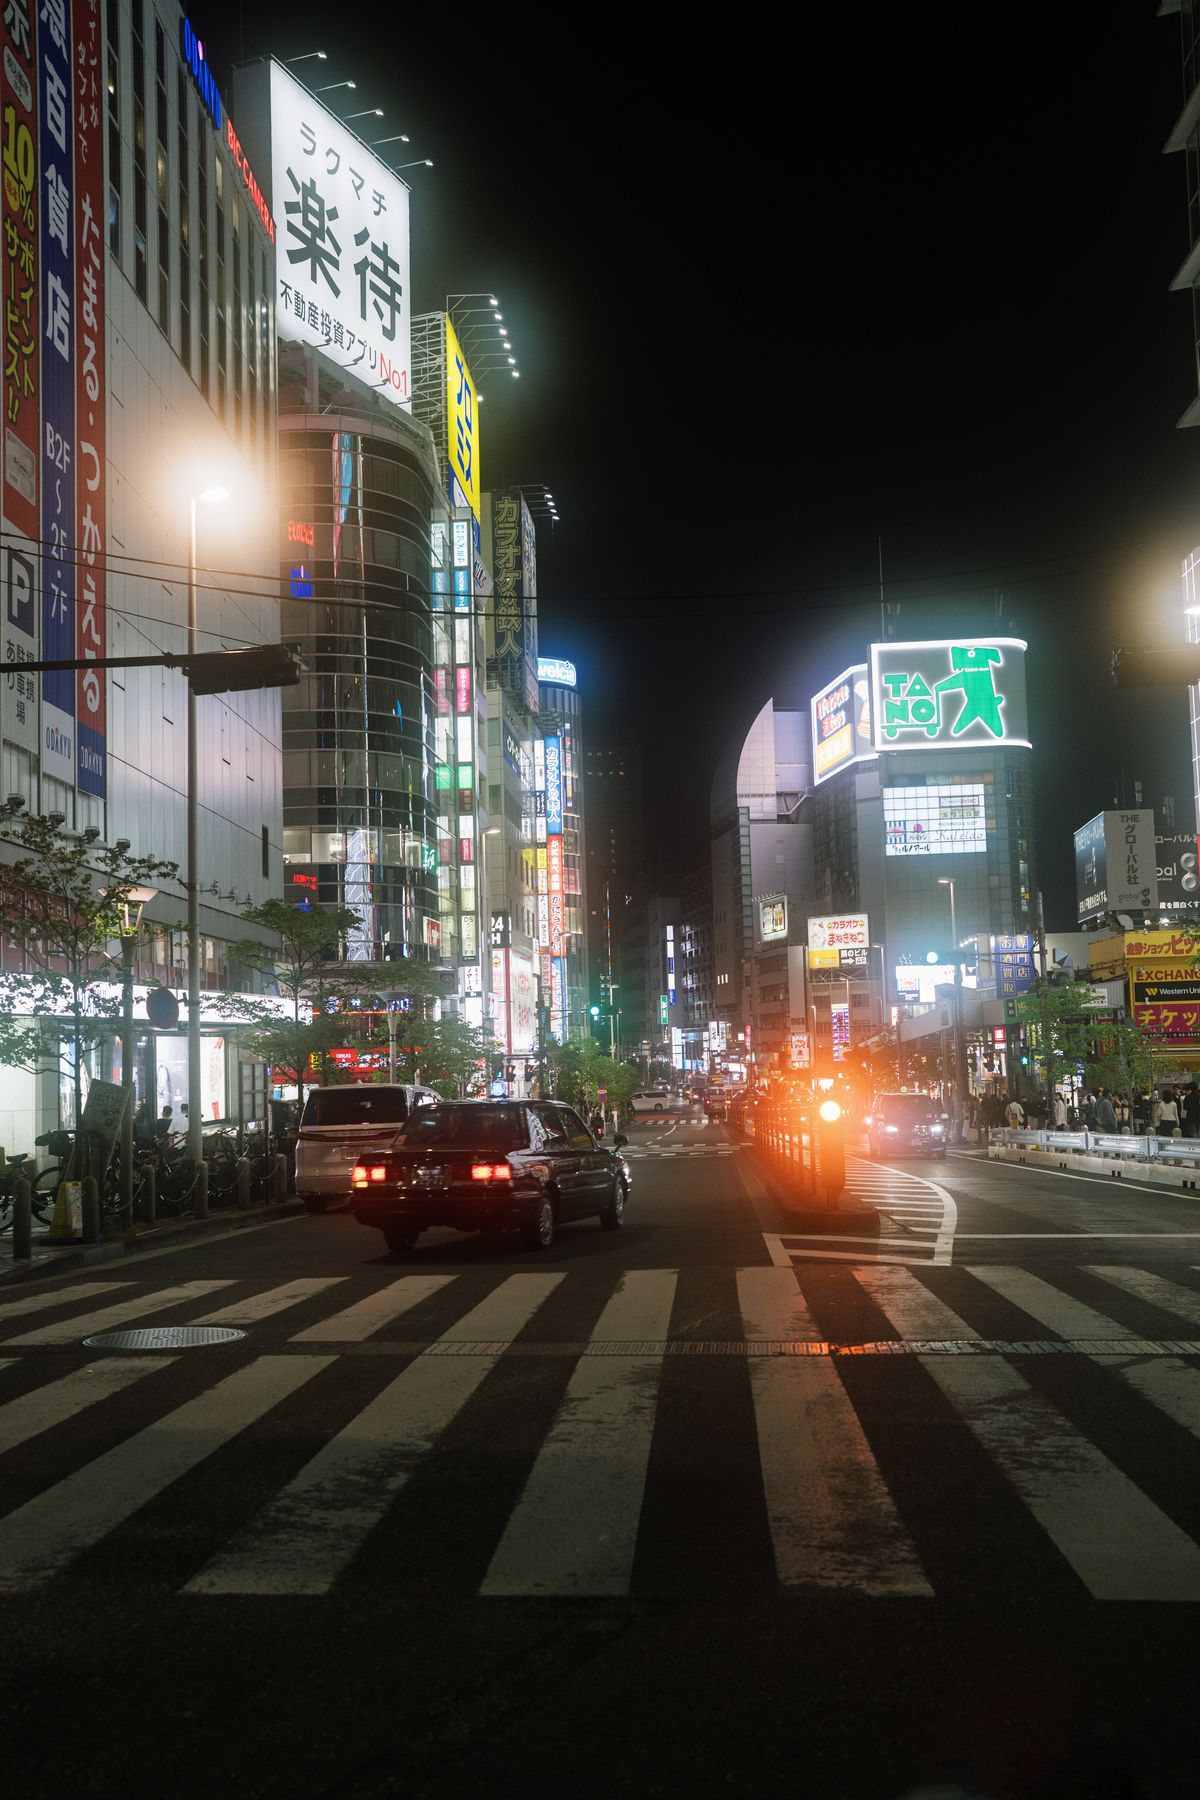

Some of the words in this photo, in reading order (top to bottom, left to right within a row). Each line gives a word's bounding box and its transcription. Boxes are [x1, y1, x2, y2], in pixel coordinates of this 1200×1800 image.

[227, 118, 243, 168] BIC
[242, 157, 275, 245] CAMERA
[300, 121, 387, 217] ラクマチ
[283, 166, 403, 342] 楽待
[279, 279, 378, 371] 不動産投資アプリ
[495, 497, 522, 657] カラオケの鉄人
[16, 644, 26, 725] 駐車場
[883, 672, 933, 698] TA
[885, 698, 936, 724] NO
[46, 726, 71, 759] ODAKYU
[546, 746, 560, 823] カラオケの鉄人
[1120, 815, 1139, 823] THE
[1124, 824, 1139, 885] グローバル社
[827, 932, 865, 946] まねきねこ
[831, 919, 859, 930] カラオケ
[1160, 987, 1189, 995] Western
